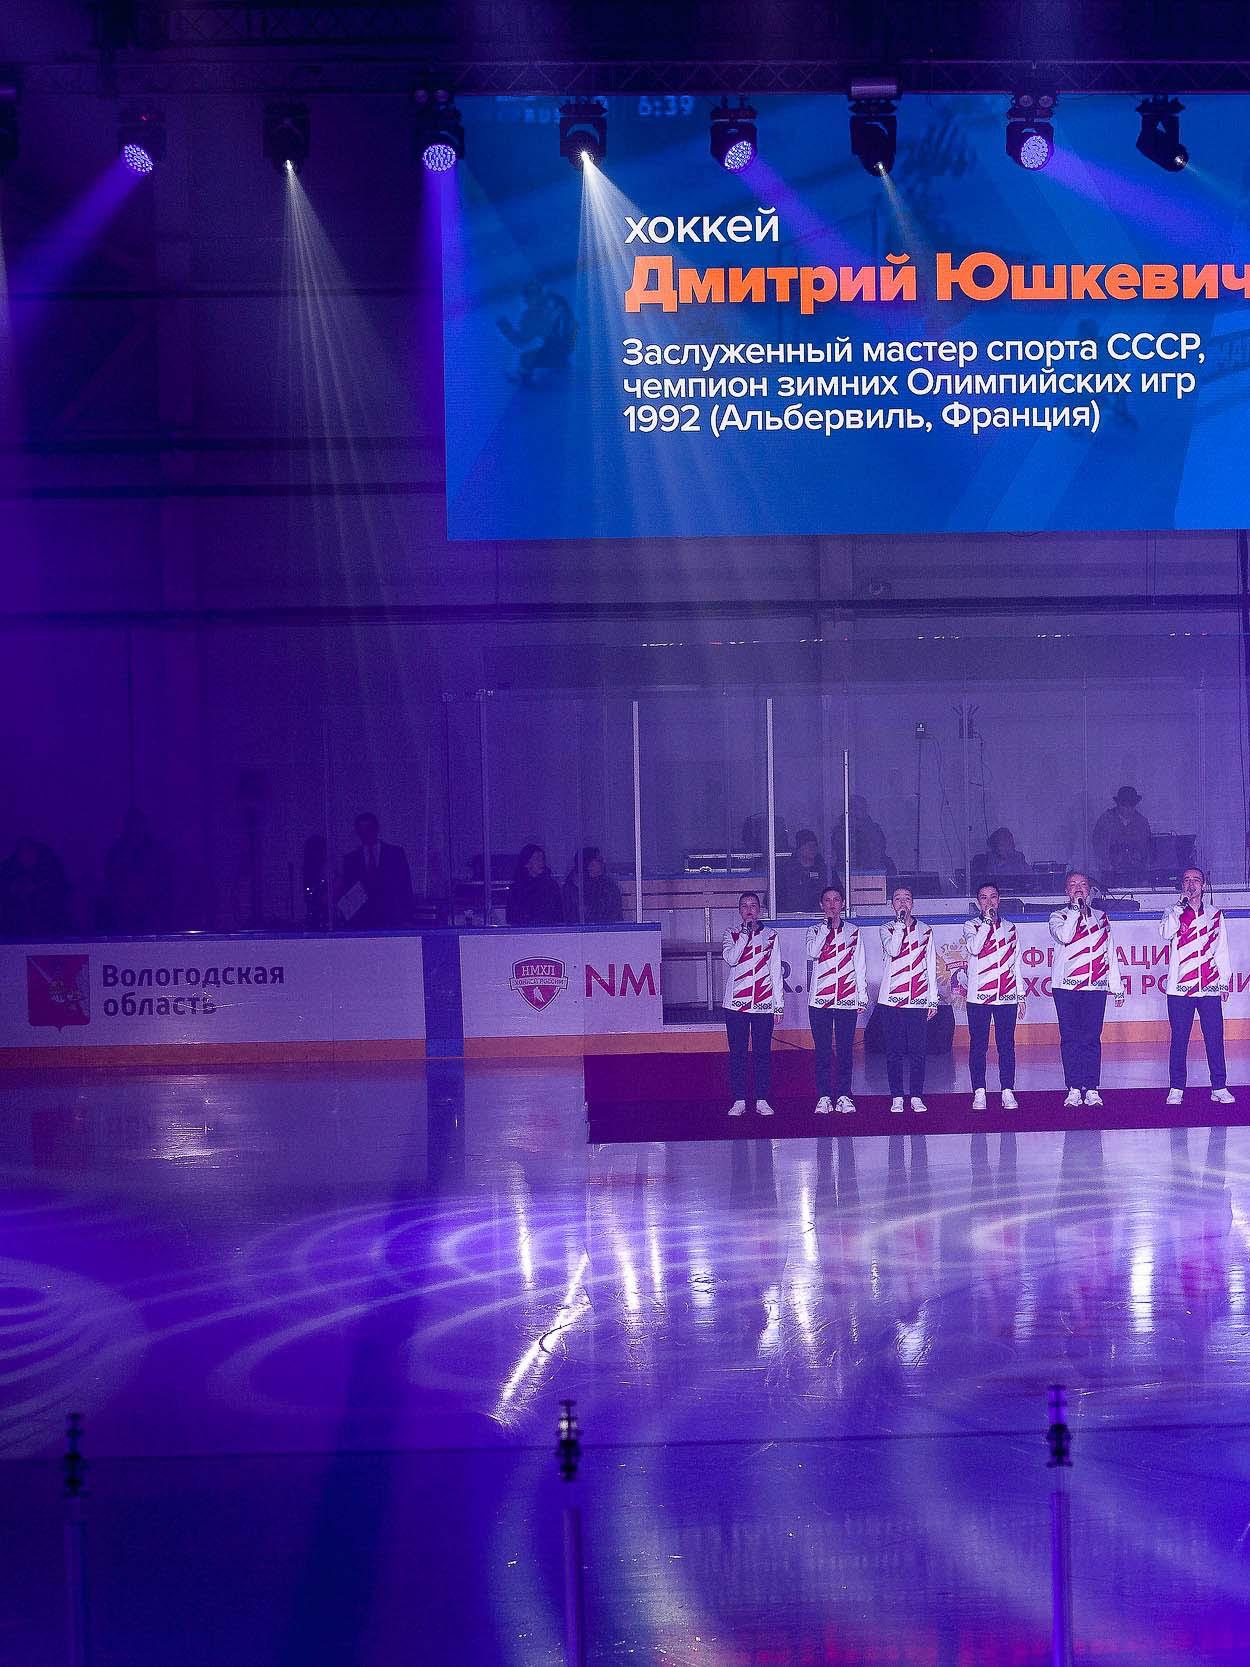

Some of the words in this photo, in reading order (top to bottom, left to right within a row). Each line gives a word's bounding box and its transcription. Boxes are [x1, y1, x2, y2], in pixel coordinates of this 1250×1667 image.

[624, 206, 779, 244] хоккей
[624, 252, 917, 315] Дмитрий
[622, 335, 853, 371] Заслуженный
[863, 339, 978, 368] мастер
[986, 339, 1098, 366] спорта
[1107, 332, 1205, 363] СССР,
[623, 375, 769, 399] чемпион
[777, 374, 899, 398] зимних
[907, 367, 1133, 396] Олимпийских
[1141, 371, 1197, 400] игр
[622, 403, 701, 433] 1992
[710, 402, 933, 438] (Альбервиль,
[941, 399, 1101, 434] Франция)
[102, 964, 285, 988] Вологодская
[521, 964, 555, 977] НМХЛ
[585, 963, 662, 997] NM
[103, 991, 217, 1016] область
